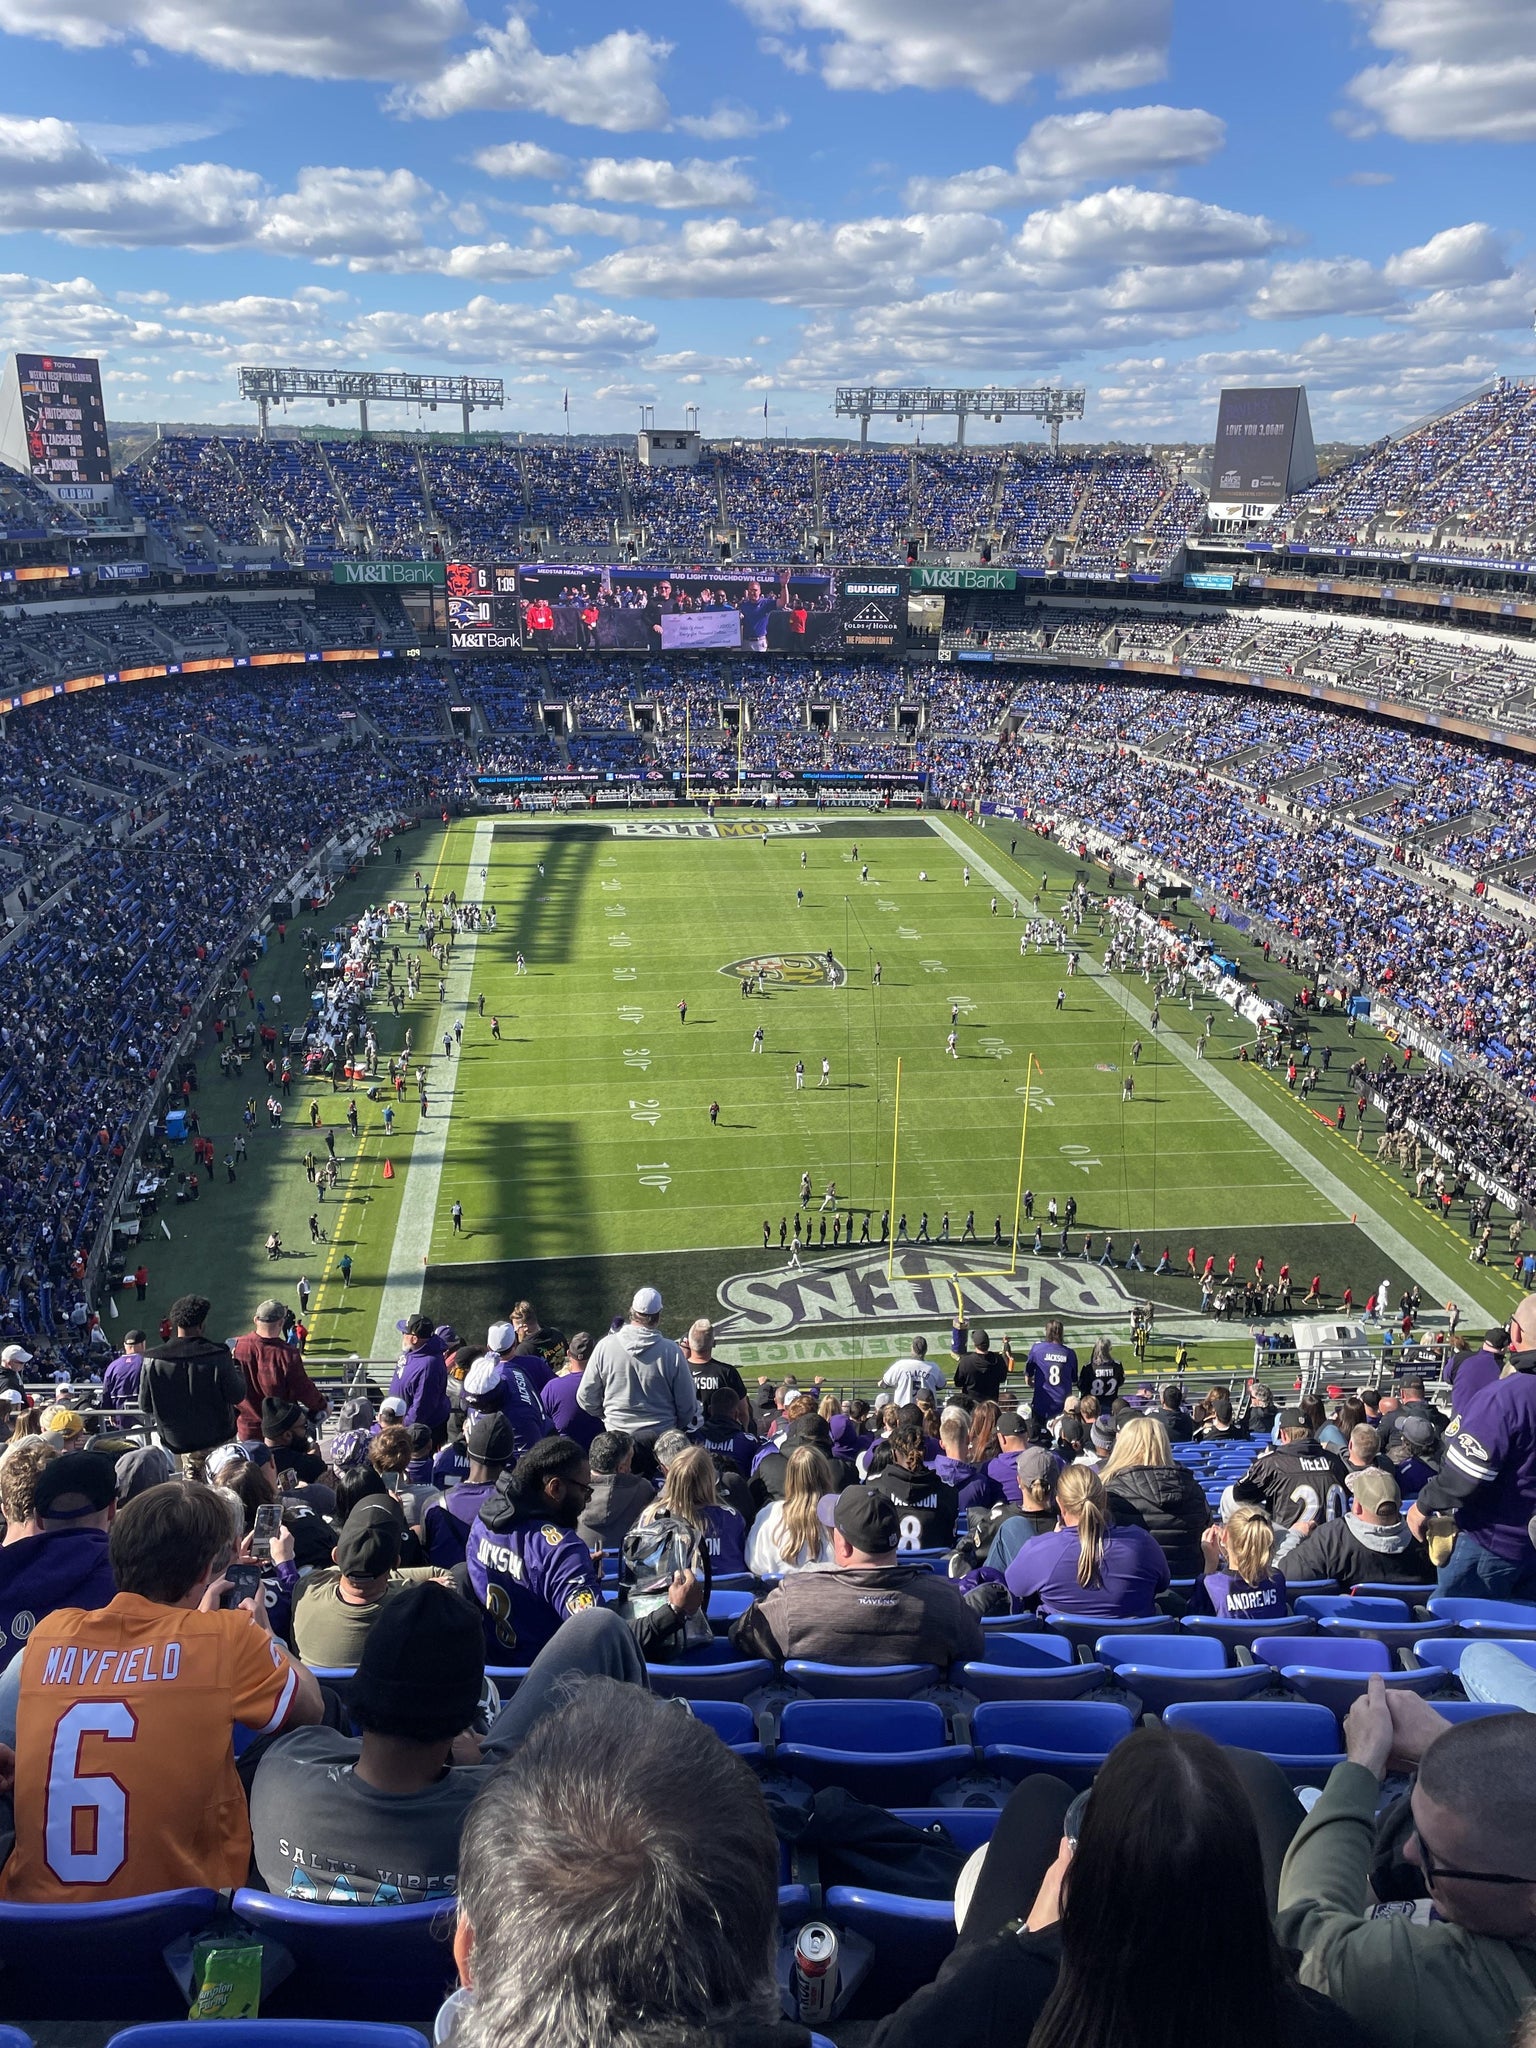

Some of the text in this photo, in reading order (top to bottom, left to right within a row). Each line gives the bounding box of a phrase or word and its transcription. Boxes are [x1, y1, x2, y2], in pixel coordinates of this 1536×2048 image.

[42, 382, 59, 393] ALLEN
[45, 408, 82, 420] HUTCHINSON
[1226, 424, 1242, 436] LOVE
[1244, 424, 1257, 436] YOU
[51, 459, 78, 471] JOHNSON
[60, 489, 92, 498] OLD BAY
[1242, 504, 1264, 518] Lite
[346, 564, 434, 582] M&T Bank
[478, 569, 487, 587] 6
[709, 574, 755, 582] TOUCHDOWN
[921, 569, 1006, 588] M&T Bank
[496, 577, 515, 592] 1:09
[847, 585, 898, 594] BUD LIGHT
[477, 602, 490, 621] 10
[872, 622, 898, 630] HONOR
[452, 633, 520, 648] M&T Bank
[625, 822, 816, 838] BALTIMORE
[1419, 1035, 1442, 1066] FLOCK
[629, 1099, 661, 1121] 20
[1059, 1145, 1103, 1167] 10
[637, 1162, 672, 1186] 10
[720, 1248, 1136, 1336] RAVENS
[1044, 1353, 1067, 1363] JACKSON
[1049, 1365, 1061, 1386] 8
[1095, 1367, 1114, 1378] SMITH
[694, 1376, 719, 1390] KSON
[1091, 1378, 1118, 1396] 82
[1300, 1456, 1331, 1471] REED
[1290, 1484, 1348, 1528] 20
[541, 1524, 563, 1546] 8
[898, 1515, 921, 1550] 8
[1226, 1588, 1277, 1612] ANDREWS
[41, 1641, 182, 1686] MAYFIELD
[43, 1698, 139, 1886] 6
[279, 1838, 457, 1891] SALTY VIBES
[199, 1983, 234, 2000] ampton
